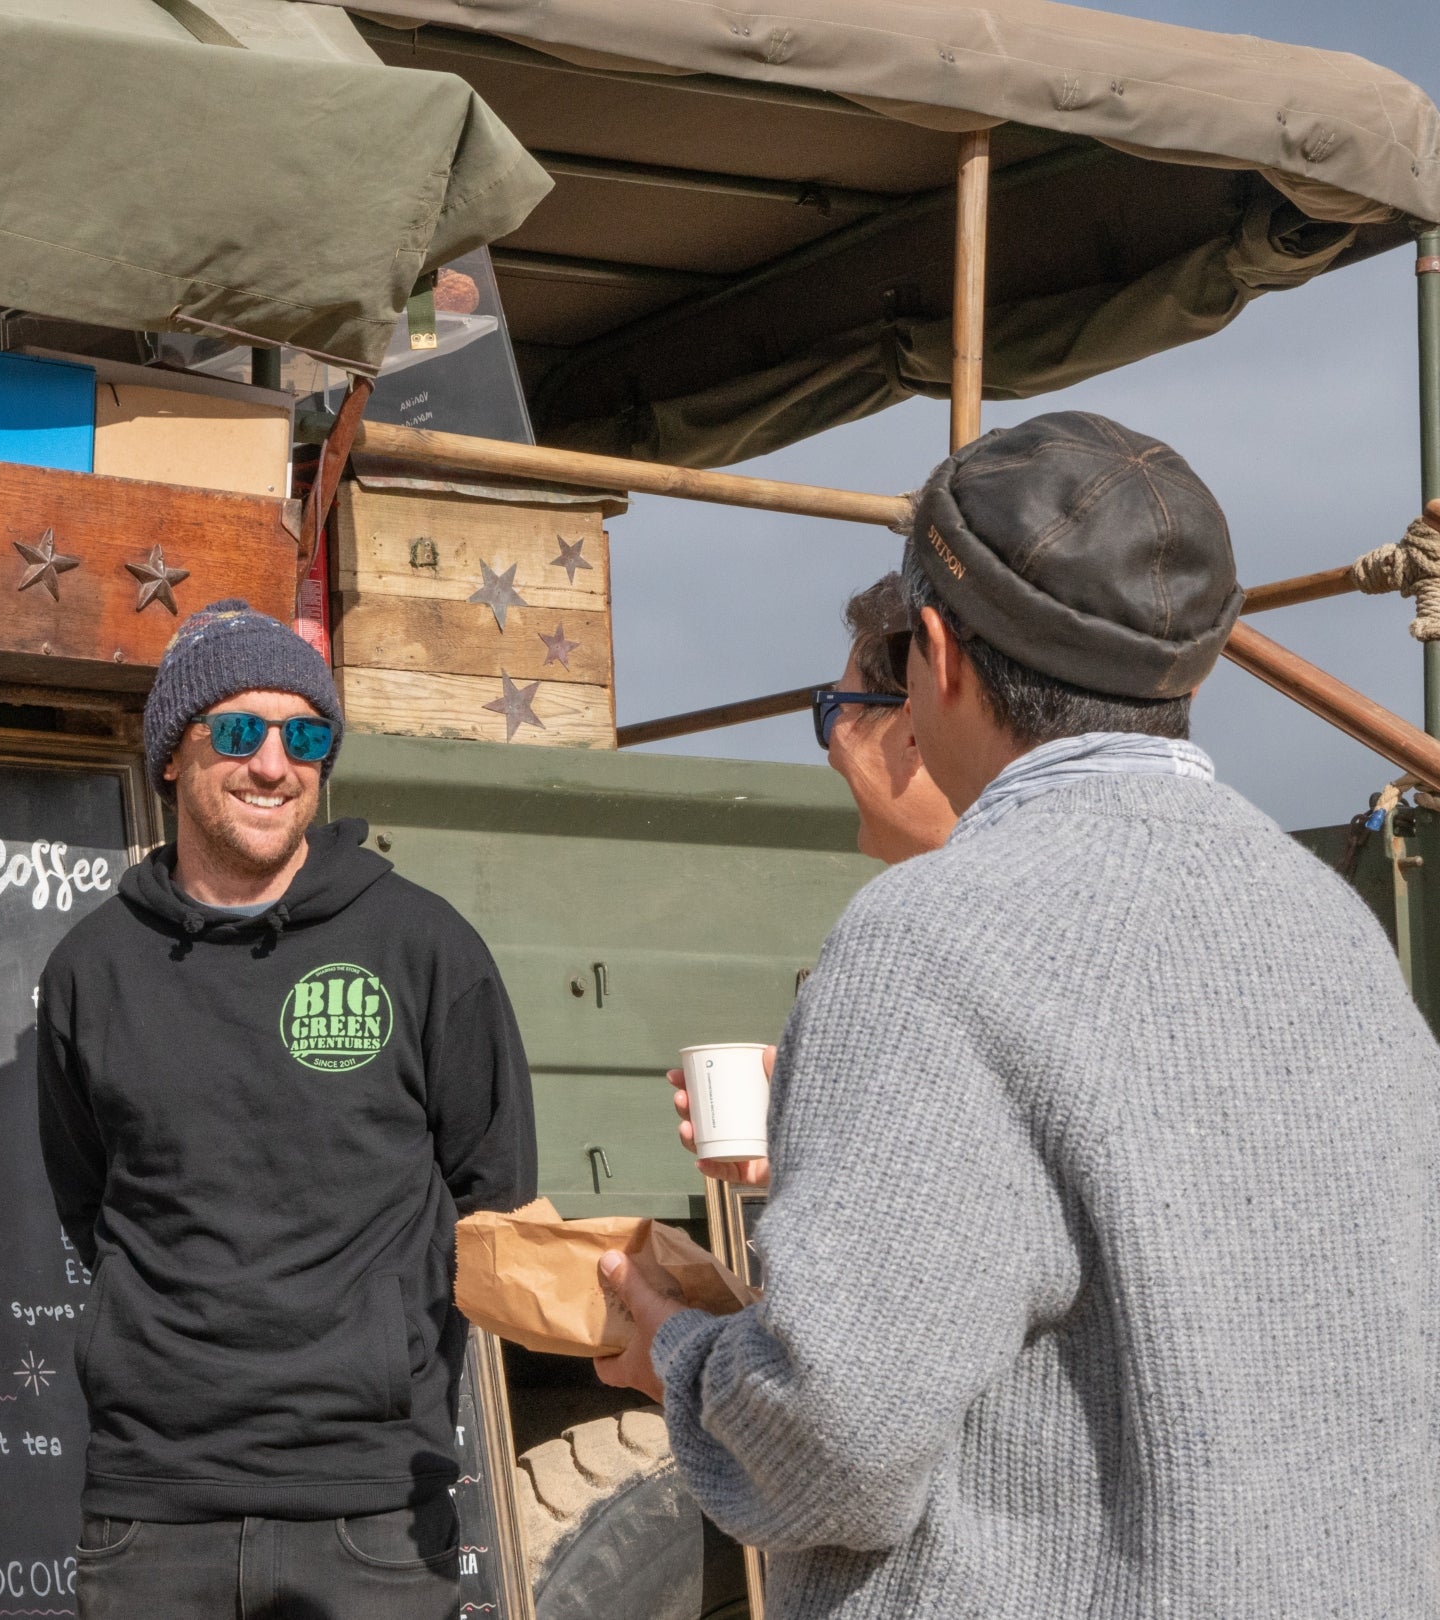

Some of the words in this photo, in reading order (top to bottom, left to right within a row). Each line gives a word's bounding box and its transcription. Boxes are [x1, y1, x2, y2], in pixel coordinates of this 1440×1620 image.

[927, 525, 967, 580] STETSON
[293, 977, 380, 1017] BIG
[291, 1016, 382, 1039] GREEN
[290, 1037, 381, 1051] ADVENTURES
[313, 1058, 338, 1069] SINCE
[339, 1058, 357, 1069] 2011
[10, 1301, 75, 1326] Syrups
[22, 1431, 62, 1457] tea
